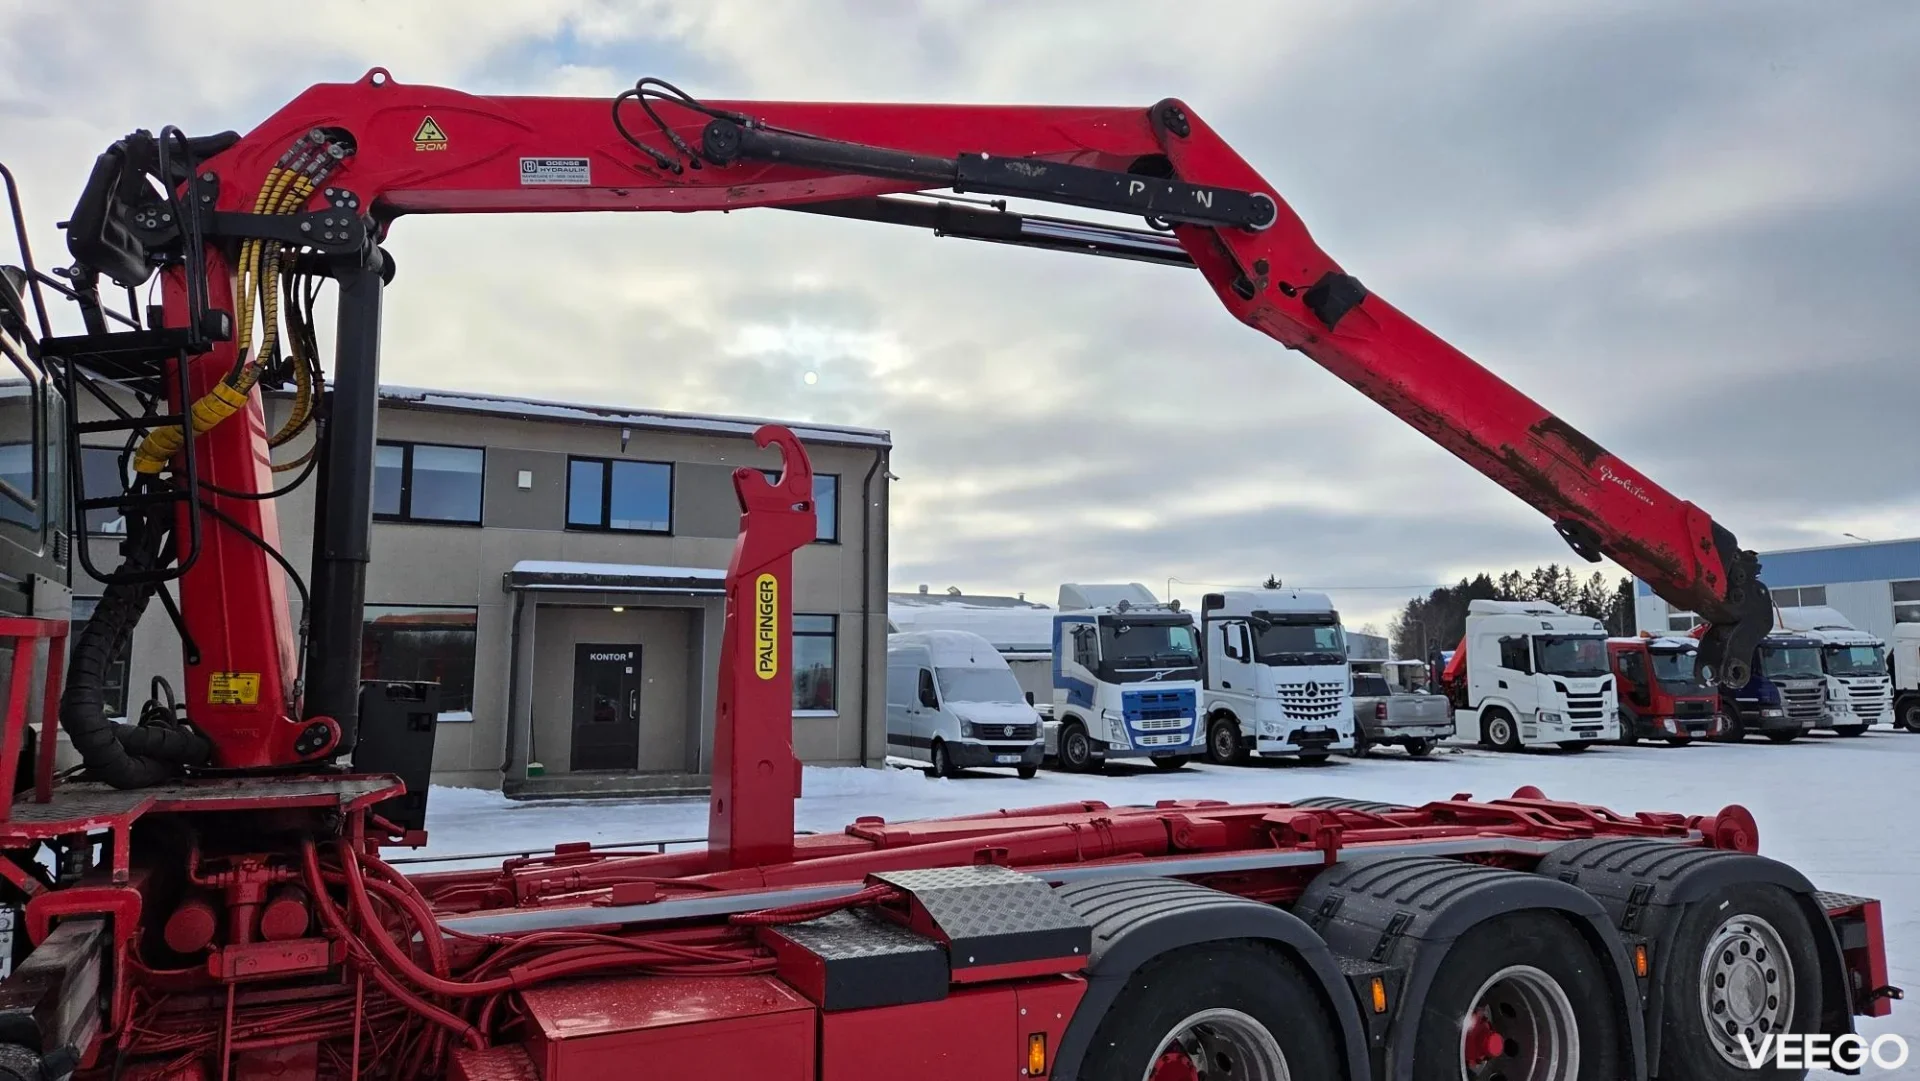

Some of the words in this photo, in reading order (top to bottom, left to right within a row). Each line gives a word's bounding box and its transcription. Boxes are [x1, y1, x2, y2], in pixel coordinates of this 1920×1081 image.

[415, 143, 448, 151] 20M
[759, 580, 774, 672] PALFINGER
[590, 653, 627, 661] KONTOR
